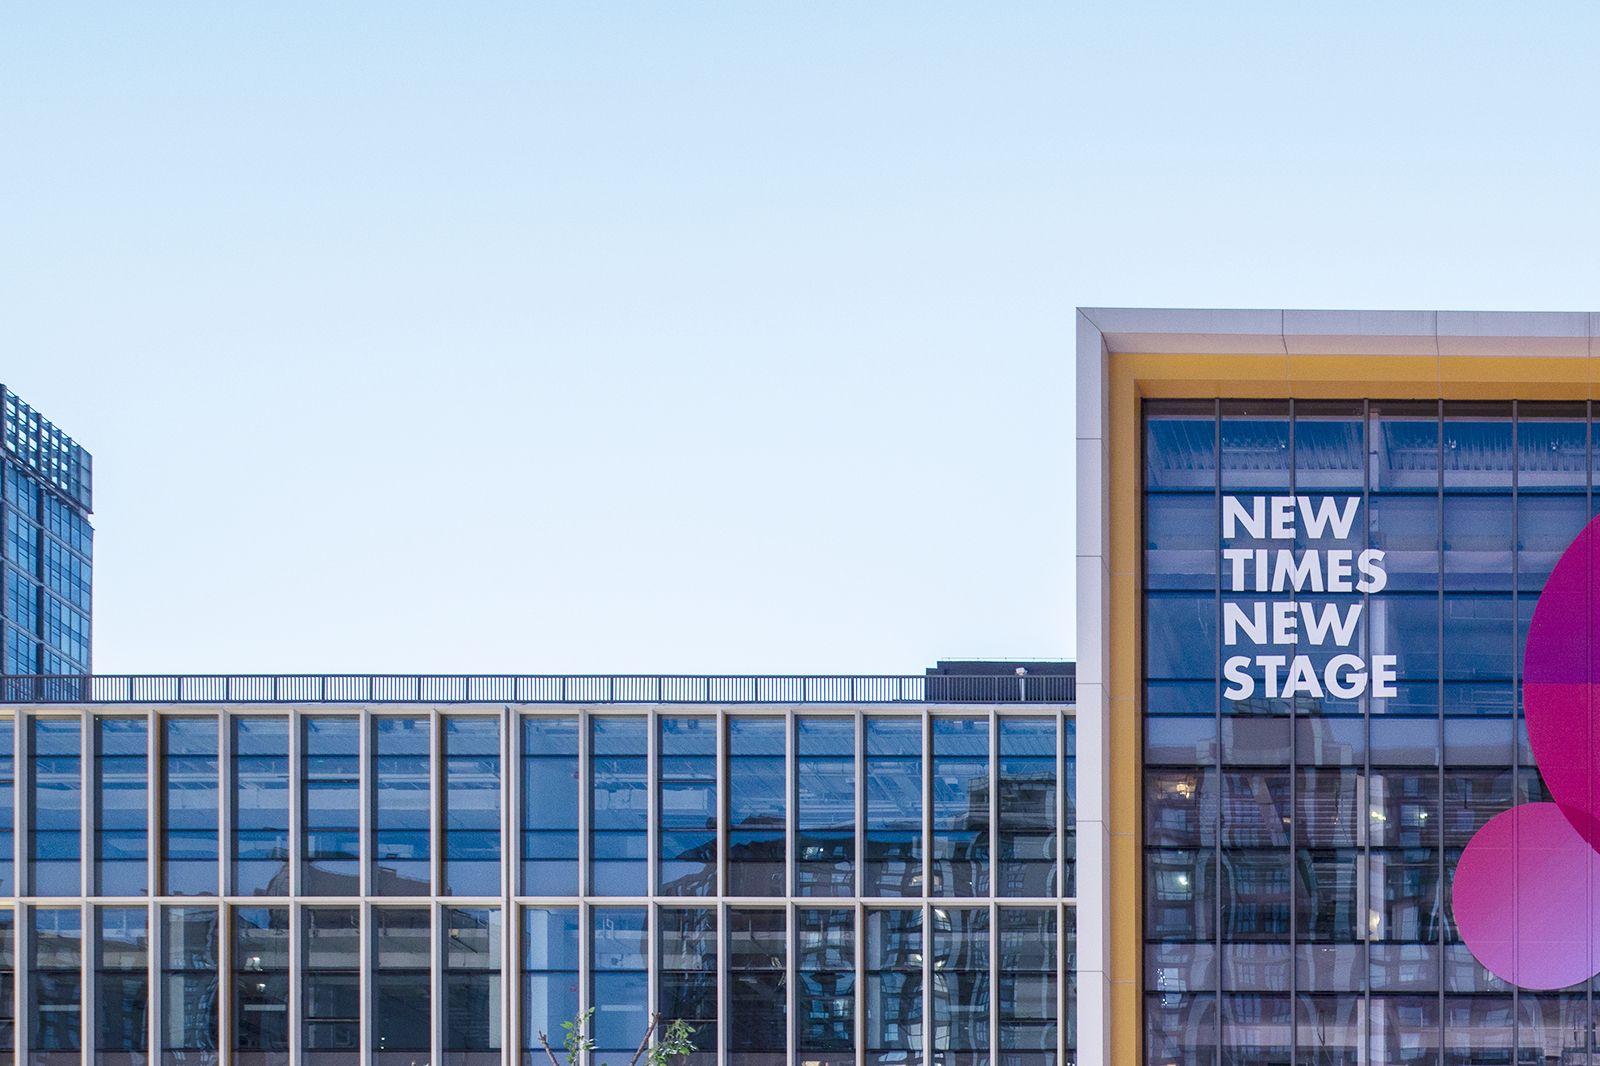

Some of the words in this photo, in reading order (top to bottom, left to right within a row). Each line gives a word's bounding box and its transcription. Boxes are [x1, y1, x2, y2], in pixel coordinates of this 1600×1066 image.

[1223, 496, 1361, 539] NEW
[1223, 549, 1387, 593] TIMES
[1223, 602, 1363, 646] NEW
[1223, 653, 1397, 700] STAGE
